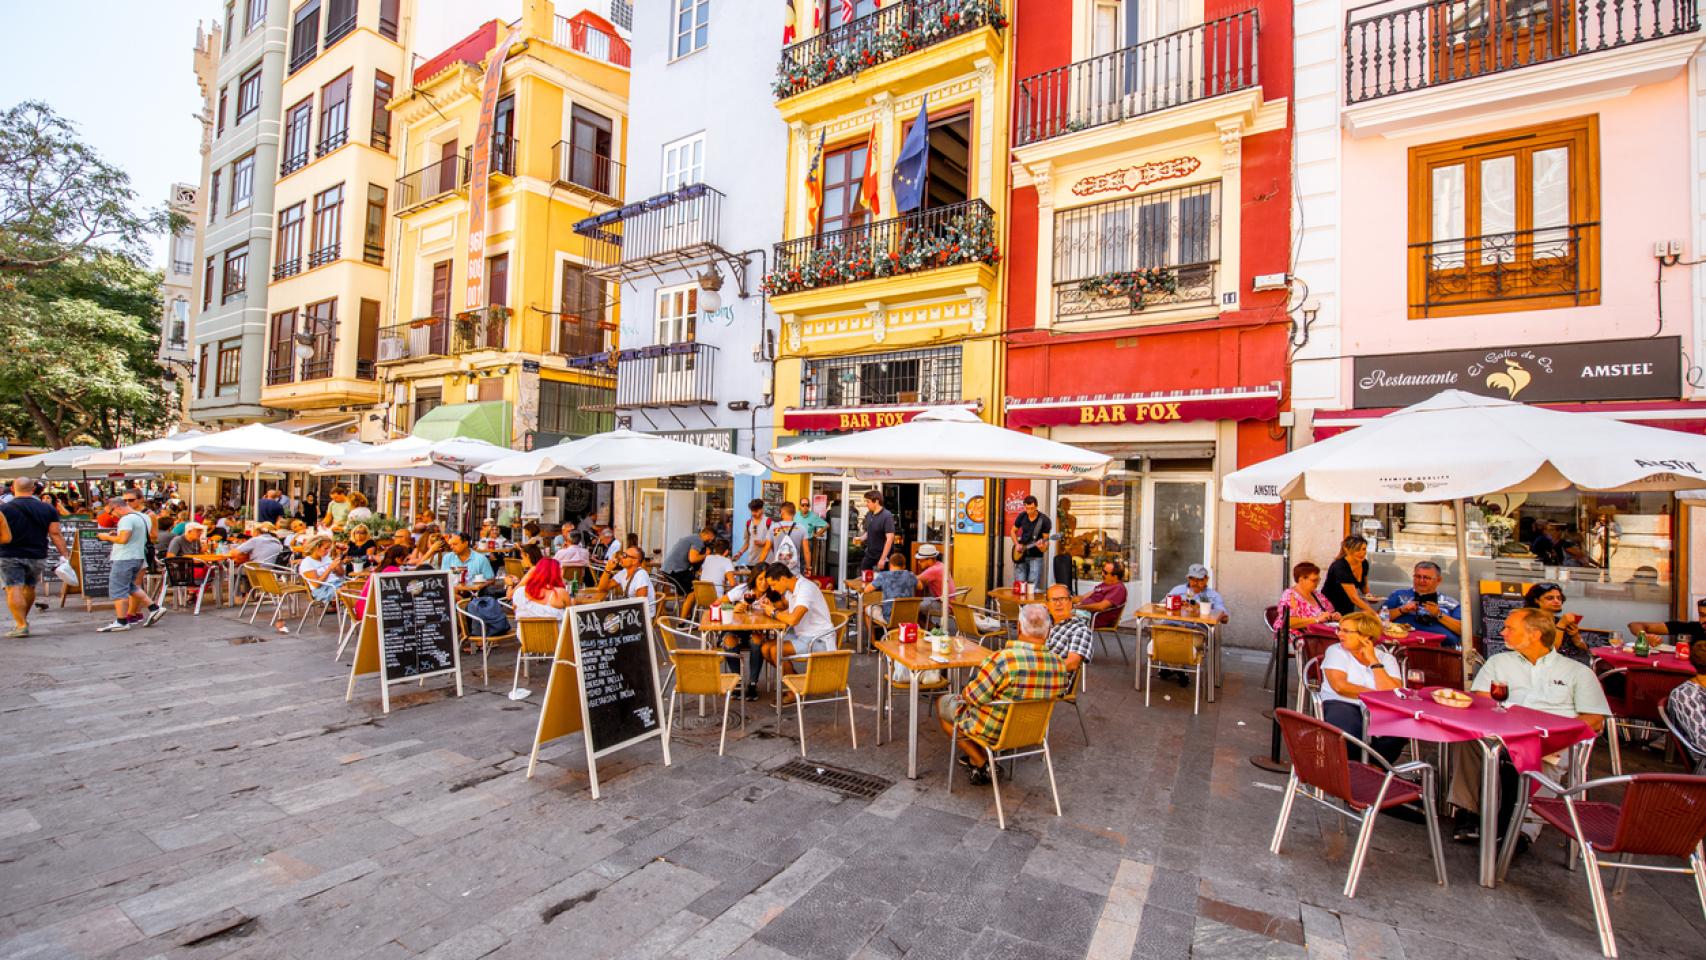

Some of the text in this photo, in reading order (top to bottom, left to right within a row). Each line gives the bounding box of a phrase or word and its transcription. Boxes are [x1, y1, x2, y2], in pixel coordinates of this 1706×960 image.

[1467, 362, 1485, 377] El
[1485, 349, 1518, 364] Gallo
[1521, 350, 1536, 360] de
[1581, 362, 1653, 378] AMSTEL
[1359, 369, 1458, 389] Restaurante
[840, 412, 905, 428] BAR FOX
[1080, 403, 1182, 424] BAR FOX
[1253, 485, 1279, 497] AMSTEL
[577, 612, 606, 637] BAR
